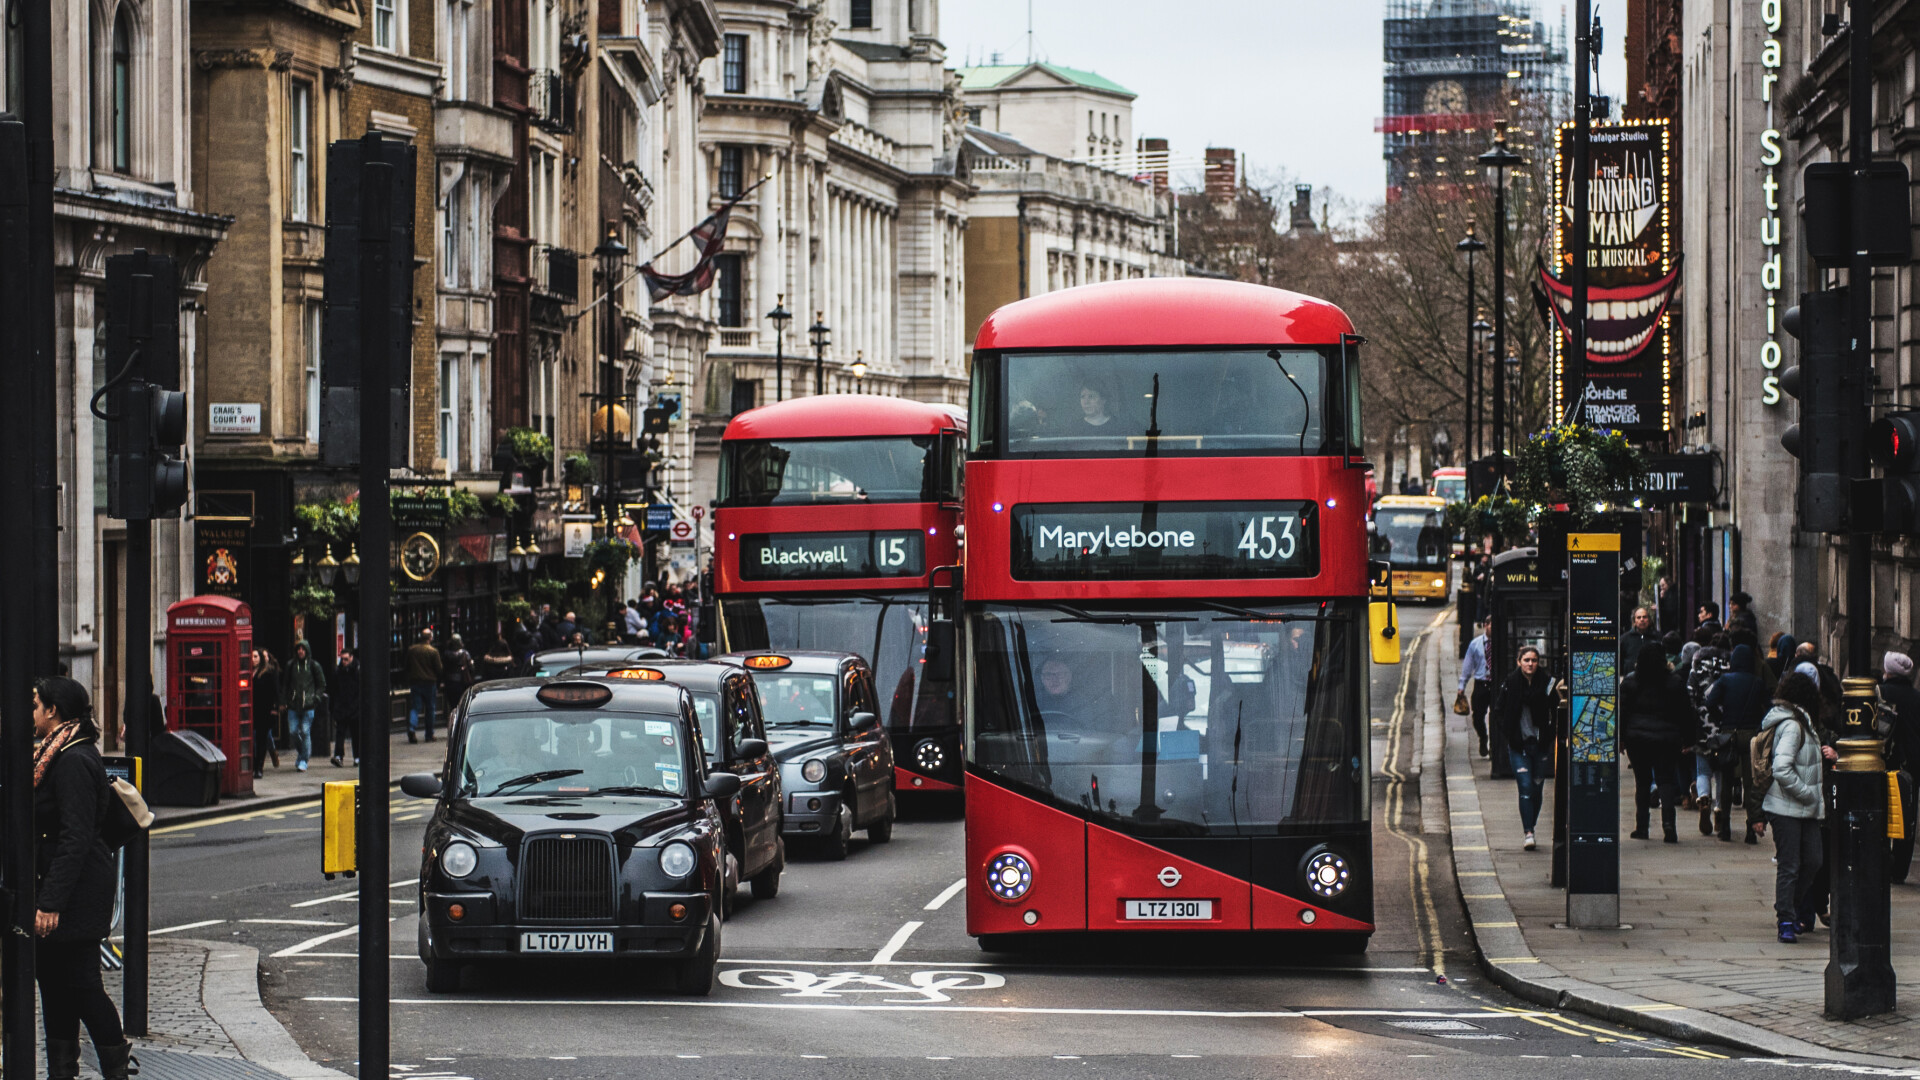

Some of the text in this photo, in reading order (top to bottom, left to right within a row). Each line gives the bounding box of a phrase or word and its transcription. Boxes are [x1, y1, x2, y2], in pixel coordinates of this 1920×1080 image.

[1620, 131, 1649, 141] Studios
[1602, 166, 1620, 178] THE
[1588, 209, 1634, 246] MAN
[1601, 248, 1648, 267] MUSICAL
[1760, 128, 1781, 405] Studios
[213, 406, 242, 414] CRAIG'S
[213, 415, 256, 424] COURT SW1
[1594, 412, 1640, 424] BETWEEN
[200, 529, 246, 538] WALKERS
[1039, 516, 1296, 559] Marylebone 453
[761, 537, 906, 567] Blackwall 15
[1507, 573, 1526, 583] WiFi
[175, 617, 226, 626] TELEPHONE
[752, 656, 781, 667] TAXI
[618, 671, 651, 680] TAXI
[1138, 902, 1199, 917] LTZ 1301
[527, 934, 607, 950] LT07 UYH
